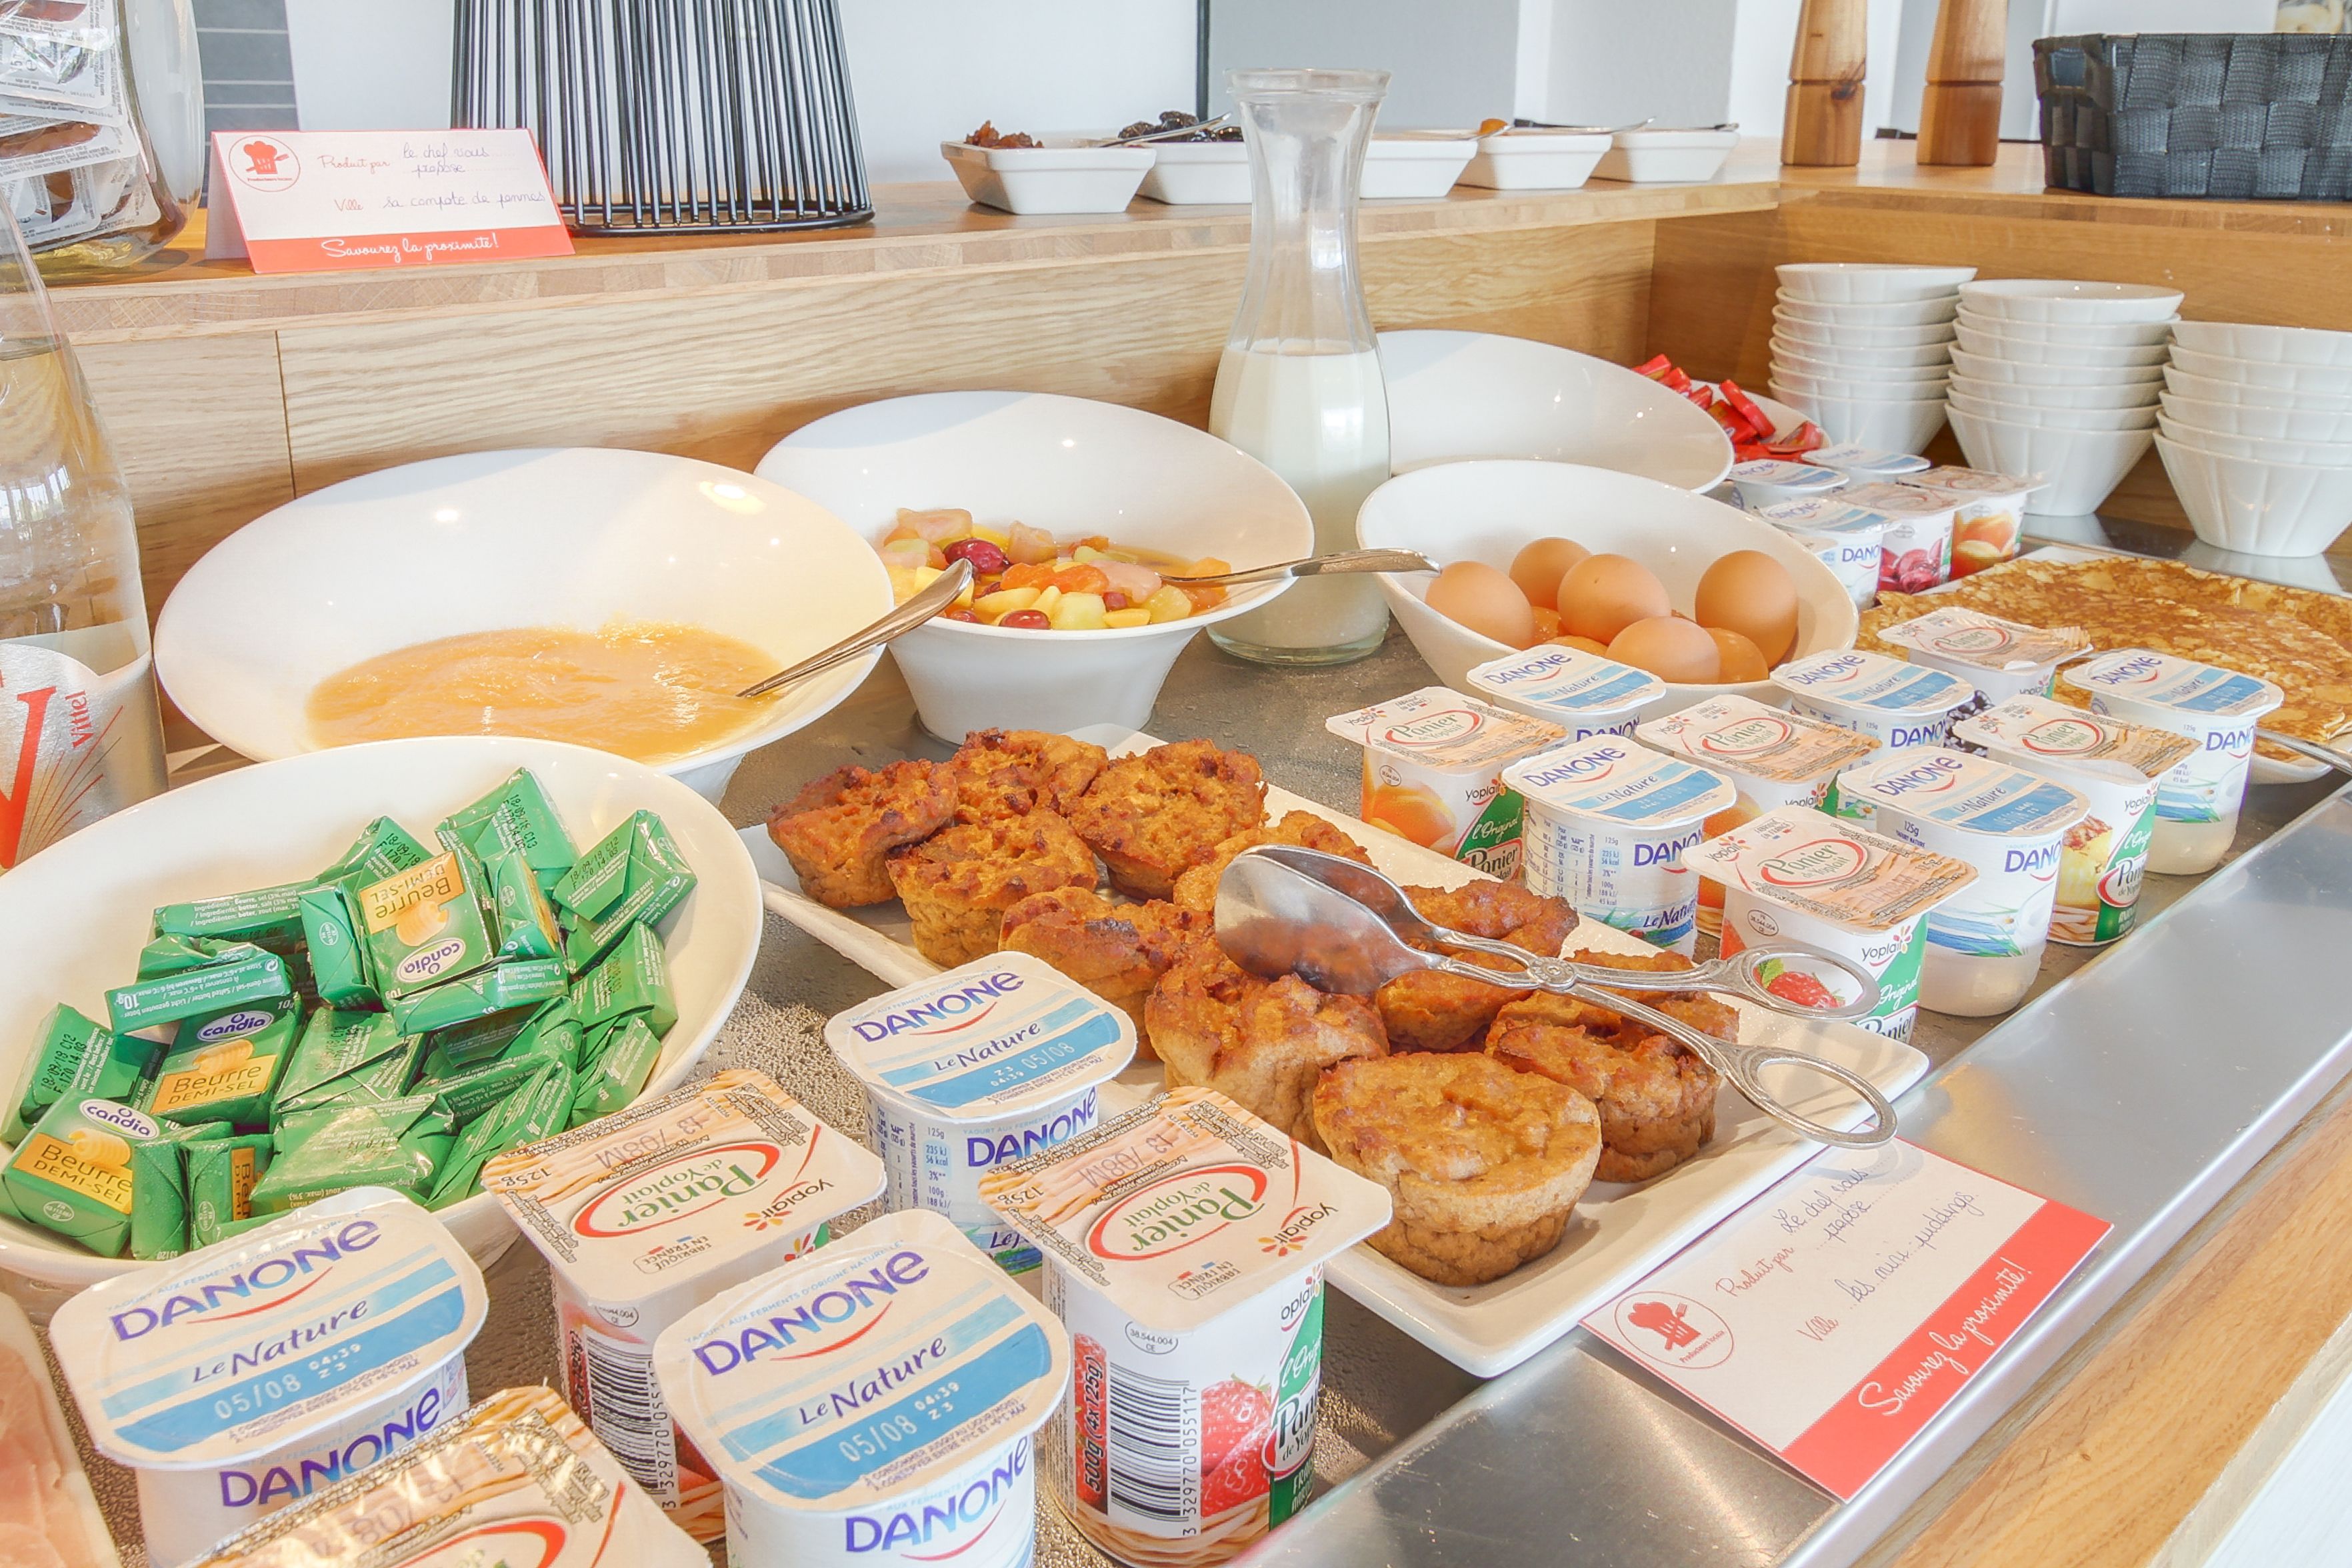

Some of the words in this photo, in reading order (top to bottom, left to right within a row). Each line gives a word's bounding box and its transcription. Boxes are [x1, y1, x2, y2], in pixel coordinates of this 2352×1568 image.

[317, 155, 366, 169] Produit
[369, 161, 390, 175] par
[423, 142, 448, 163] chef
[454, 145, 490, 158] vous
[334, 199, 363, 212] Ville
[411, 191, 467, 210] compote
[472, 193, 491, 205] de
[321, 239, 401, 264] Savourez
[402, 237, 419, 254] la
[421, 232, 500, 261] proximité!
[1557, 674, 1600, 695] Nature
[1867, 675, 1902, 695] Nature
[65, 689, 94, 749] Vittel
[1385, 713, 1461, 739] Panier
[1699, 719, 1767, 746] Panier
[1524, 747, 1626, 787] DANONE
[1871, 755, 1963, 797] DANONE
[1465, 783, 1500, 801] Yoplait
[1609, 773, 1659, 800] Nature
[1966, 785, 2007, 812] Nature
[1605, 836, 1619, 847] 125g
[1903, 819, 1920, 837] 125g
[605, 836, 620, 853] C12
[1705, 840, 1741, 863] Yoplait
[1757, 843, 1840, 875] Panier
[1813, 855, 1851, 877] Yoplait
[369, 863, 447, 903] DEMI-SEL
[374, 877, 452, 919] Beurre
[1643, 915, 1658, 928] Le
[403, 942, 461, 974] candia
[1861, 939, 1902, 961] Yoplait
[191, 991, 211, 1003] butter
[211, 987, 231, 998] Salted
[235, 979, 261, 992] demi-sel
[115, 991, 140, 1012] 10g
[169, 997, 187, 1008] Licht
[277, 999, 295, 1011] 10g
[851, 971, 1025, 1043] DANONE
[202, 1013, 266, 1037] candia
[59, 1032, 77, 1051] C12
[933, 1057, 957, 1073] Le
[957, 1021, 1041, 1068] Nature
[1021, 1041, 1076, 1071] 05/08
[167, 1080, 258, 1105] DEMI-SEL
[173, 1065, 262, 1094] Beurre
[87, 1104, 151, 1137] candia
[677, 1116, 705, 1135] 13
[927, 1126, 945, 1139] 125g
[967, 1086, 1097, 1168] DANONE
[925, 1144, 939, 1155] 235
[1145, 1133, 1175, 1154] 13
[41, 1143, 133, 1193] Beurre
[703, 1158, 723, 1171] de
[925, 1155, 935, 1164] 56
[936, 1156, 949, 1167] kcal
[33, 1159, 125, 1205] DEMI-SEL
[501, 1167, 552, 1187] 125g
[623, 1167, 705, 1205] Yoplait
[1194, 1181, 1211, 1194] de
[617, 1163, 767, 1228] Panier
[761, 1178, 835, 1219] Yoplait
[926, 1197, 938, 1207] 188
[997, 1185, 1045, 1205] 125g
[1801, 1189, 1835, 1222] chef
[1829, 1168, 1869, 1199] vous
[1123, 1190, 1196, 1228] Yoplait
[1130, 1187, 1265, 1251] Panier
[1819, 1198, 1873, 1244] propose
[1914, 1190, 1985, 1251] puddings
[1274, 1202, 1339, 1245] Yoplait
[644, 1241, 689, 1265] FRANCE
[696, 1235, 709, 1245] EN
[991, 1231, 1012, 1249] Le
[1177, 1267, 1216, 1290] FRANCE
[1217, 1260, 1233, 1270] EN
[1715, 1258, 1775, 1297] Produit
[1771, 1246, 1795, 1274] par
[109, 1219, 382, 1343] DANONE
[728, 1312, 750, 1326] AUX
[749, 1291, 801, 1319] FERMENTS
[801, 1268, 849, 1297] D'ORIGINE
[692, 1249, 931, 1377] DANONE
[192, 1361, 225, 1383] Le
[230, 1297, 369, 1378] Nature
[1129, 1327, 1173, 1346] 38.544.004
[1796, 1315, 1840, 1343] Ville
[1857, 1347, 1969, 1417] Savourez
[1928, 1329, 1968, 1352] la
[1961, 1257, 2033, 1347] proximité!
[213, 1373, 302, 1421] 05/08
[308, 1342, 363, 1372] 04:39
[647, 1359, 669, 1421] 055117
[798, 1402, 829, 1426] Le
[829, 1337, 947, 1419] Nature
[1084, 1355, 1103, 1440] (4x125g)
[838, 1413, 919, 1463] 05/08
[914, 1381, 960, 1411] 04:39
[1183, 1386, 1197, 1449] 055117
[219, 1387, 441, 1508] DANONE
[653, 1429, 676, 1489] 329770
[1084, 1439, 1105, 1493] 500g
[844, 1435, 1029, 1553] DANONE
[1183, 1455, 1197, 1517] 329770
[662, 1500, 677, 1510] 3
[1183, 1527, 1197, 1536] 3
